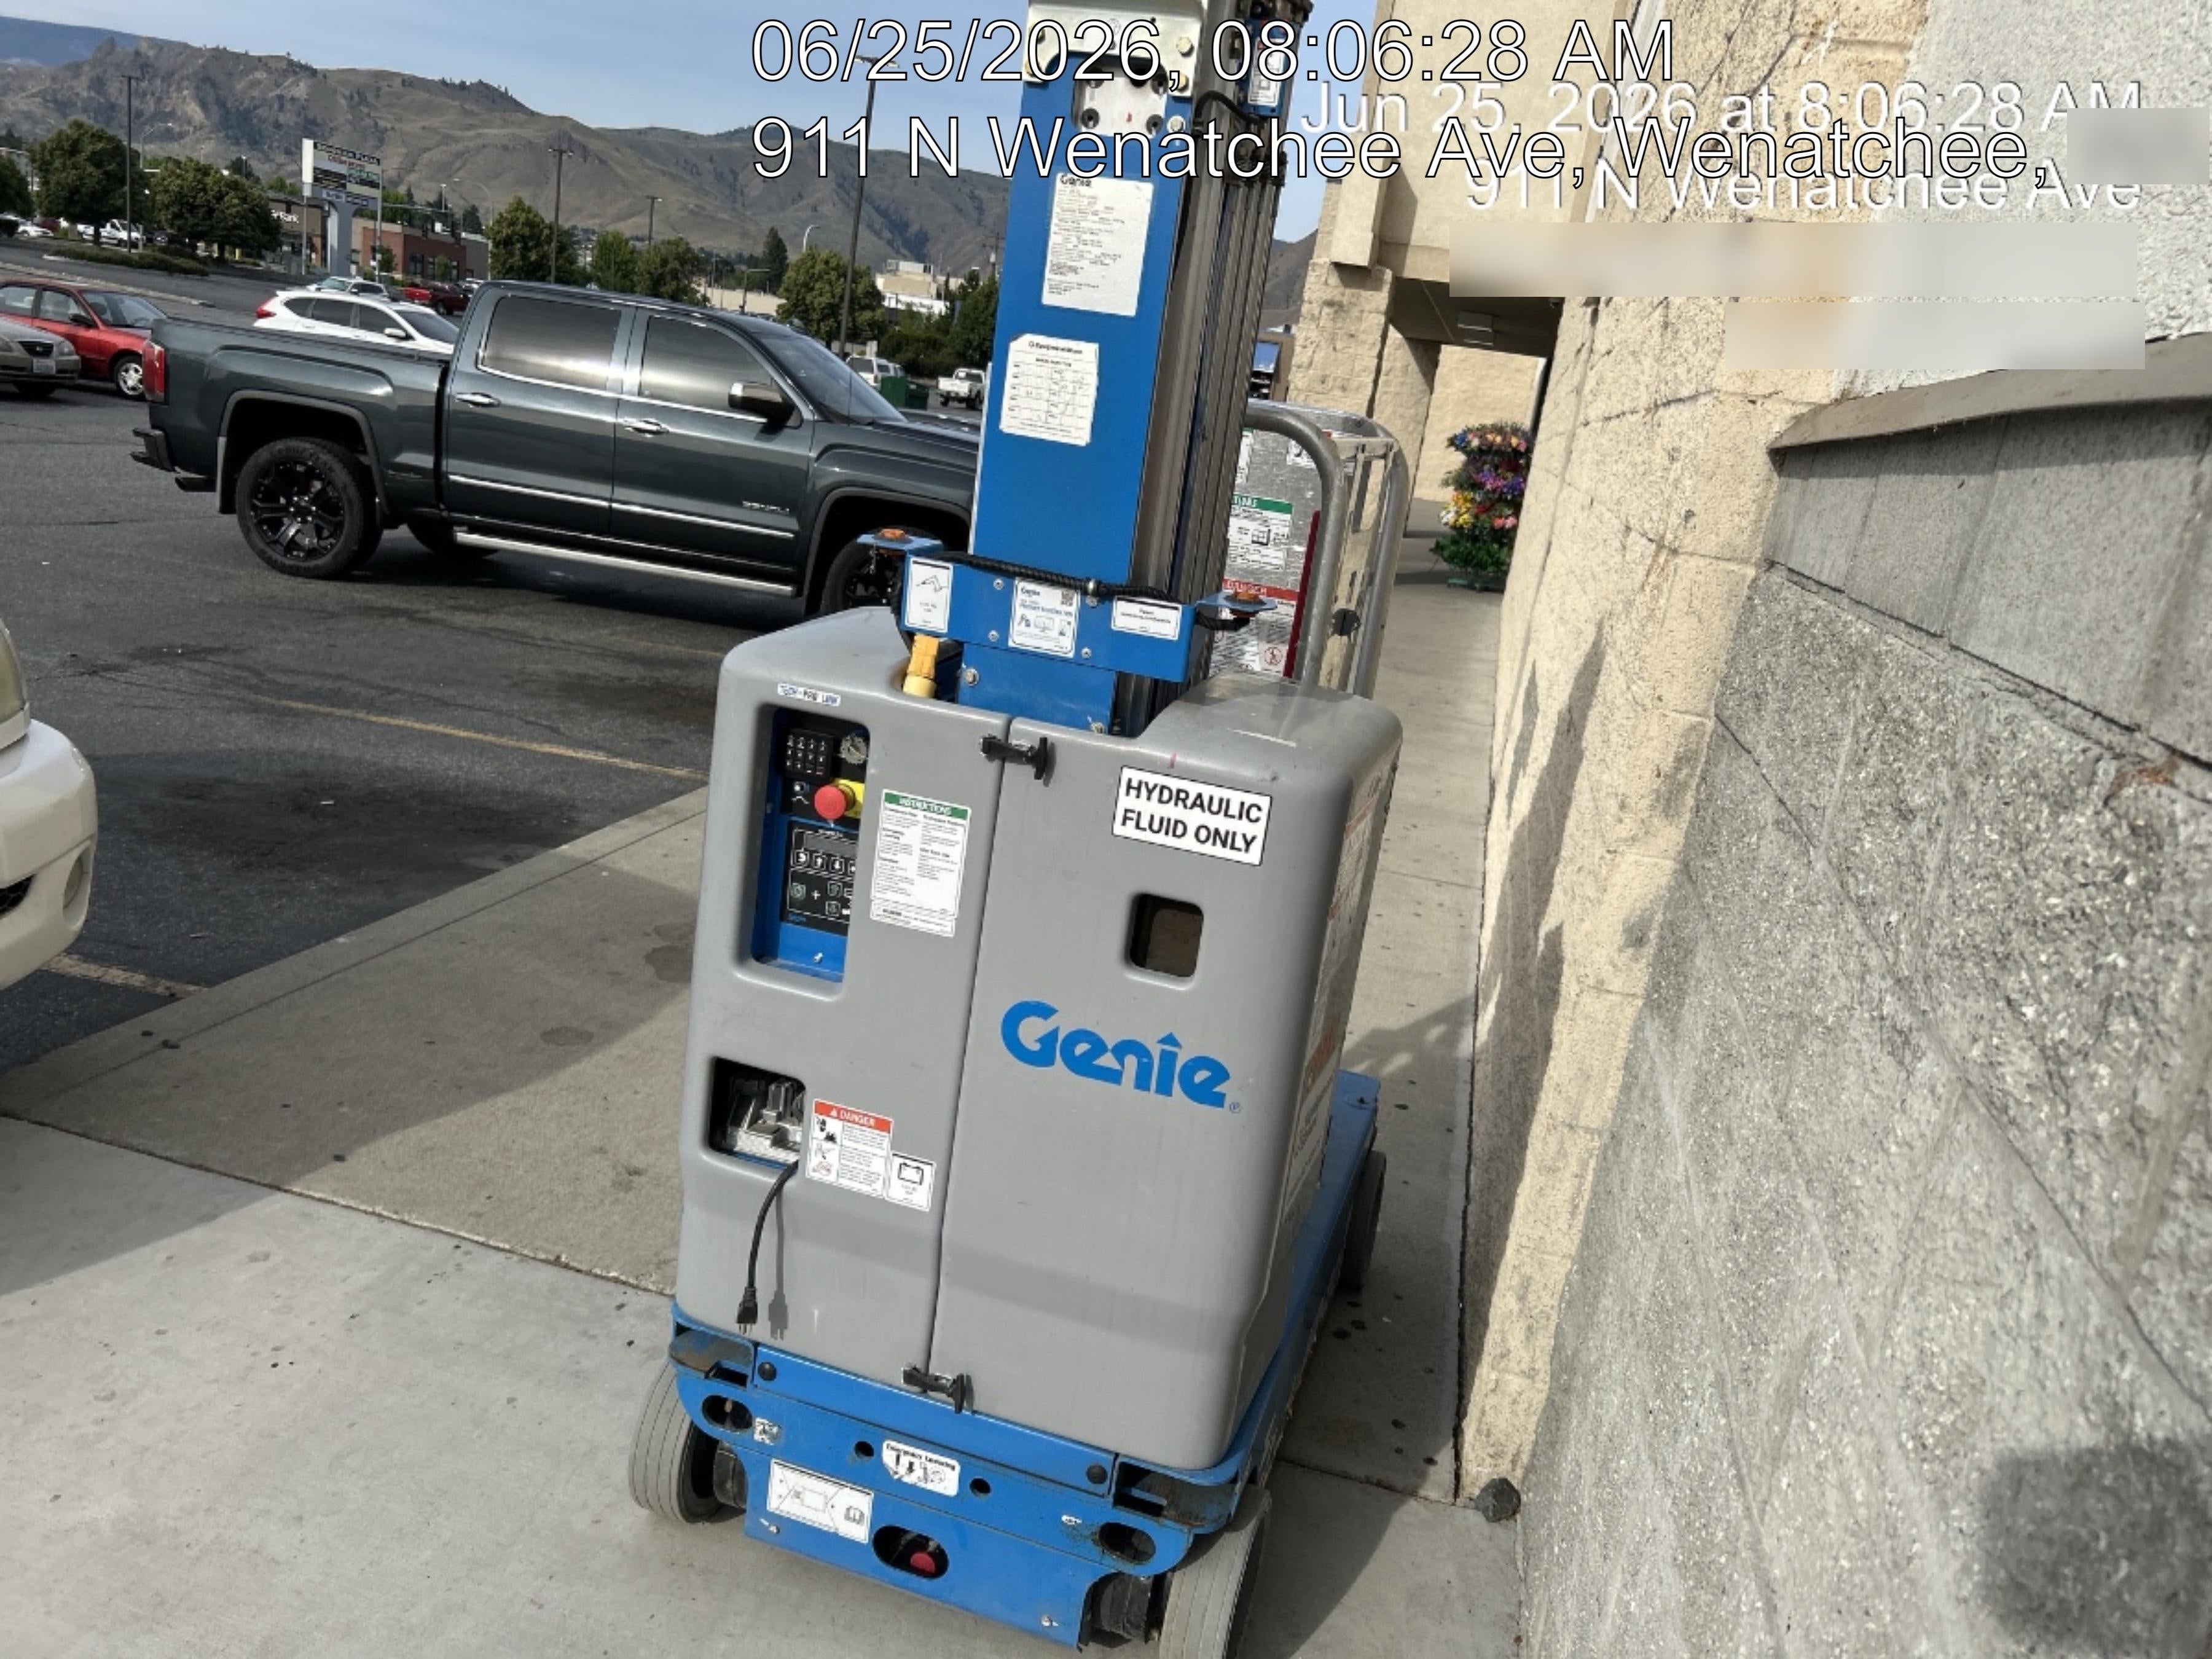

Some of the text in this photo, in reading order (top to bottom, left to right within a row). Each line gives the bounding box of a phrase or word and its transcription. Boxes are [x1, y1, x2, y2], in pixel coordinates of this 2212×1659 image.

[1125, 777, 1263, 823] HYDRAULIC
[1120, 808, 1258, 854] FLUID ONLY
[1000, 1000, 1231, 1108] Genie
